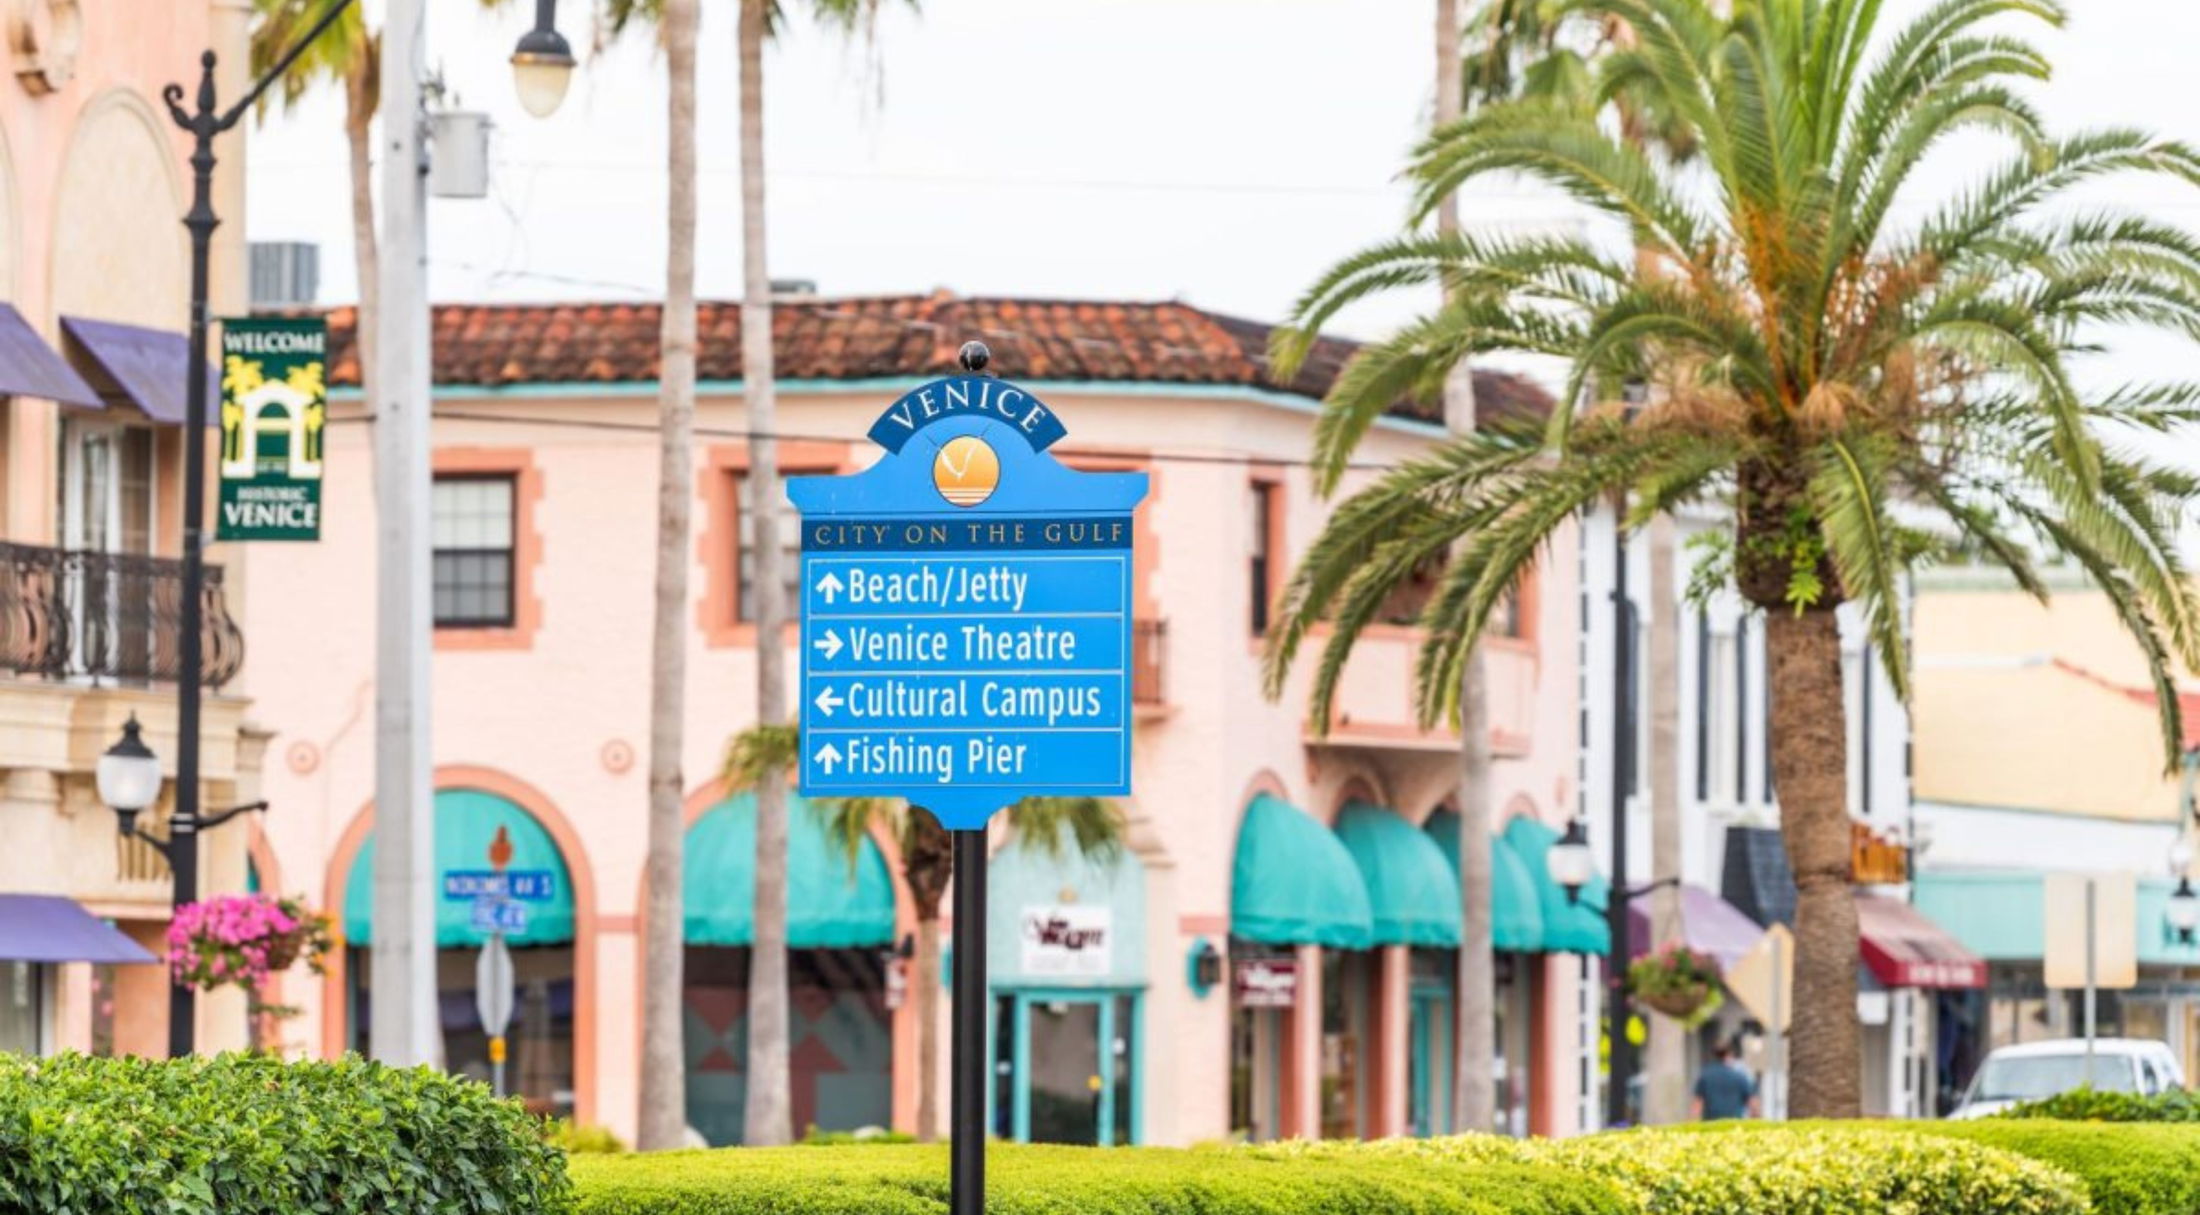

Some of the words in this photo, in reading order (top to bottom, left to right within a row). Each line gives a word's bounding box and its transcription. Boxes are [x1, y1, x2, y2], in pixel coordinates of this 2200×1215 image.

[224, 331, 325, 354] WELCOME
[889, 380, 1046, 433] VENICE
[224, 502, 317, 528] VENICE
[815, 524, 889, 545] CITY
[905, 523, 948, 544] ON
[967, 523, 1025, 544] THE
[1045, 522, 1123, 543] GULF
[849, 565, 1028, 611] Beach/Jetty
[849, 624, 948, 661] Venice
[961, 624, 1076, 661] Theatre
[848, 679, 969, 718] Cultural
[982, 681, 1101, 726] Campus
[847, 736, 954, 784] Fishing
[968, 736, 1028, 774] Pier
